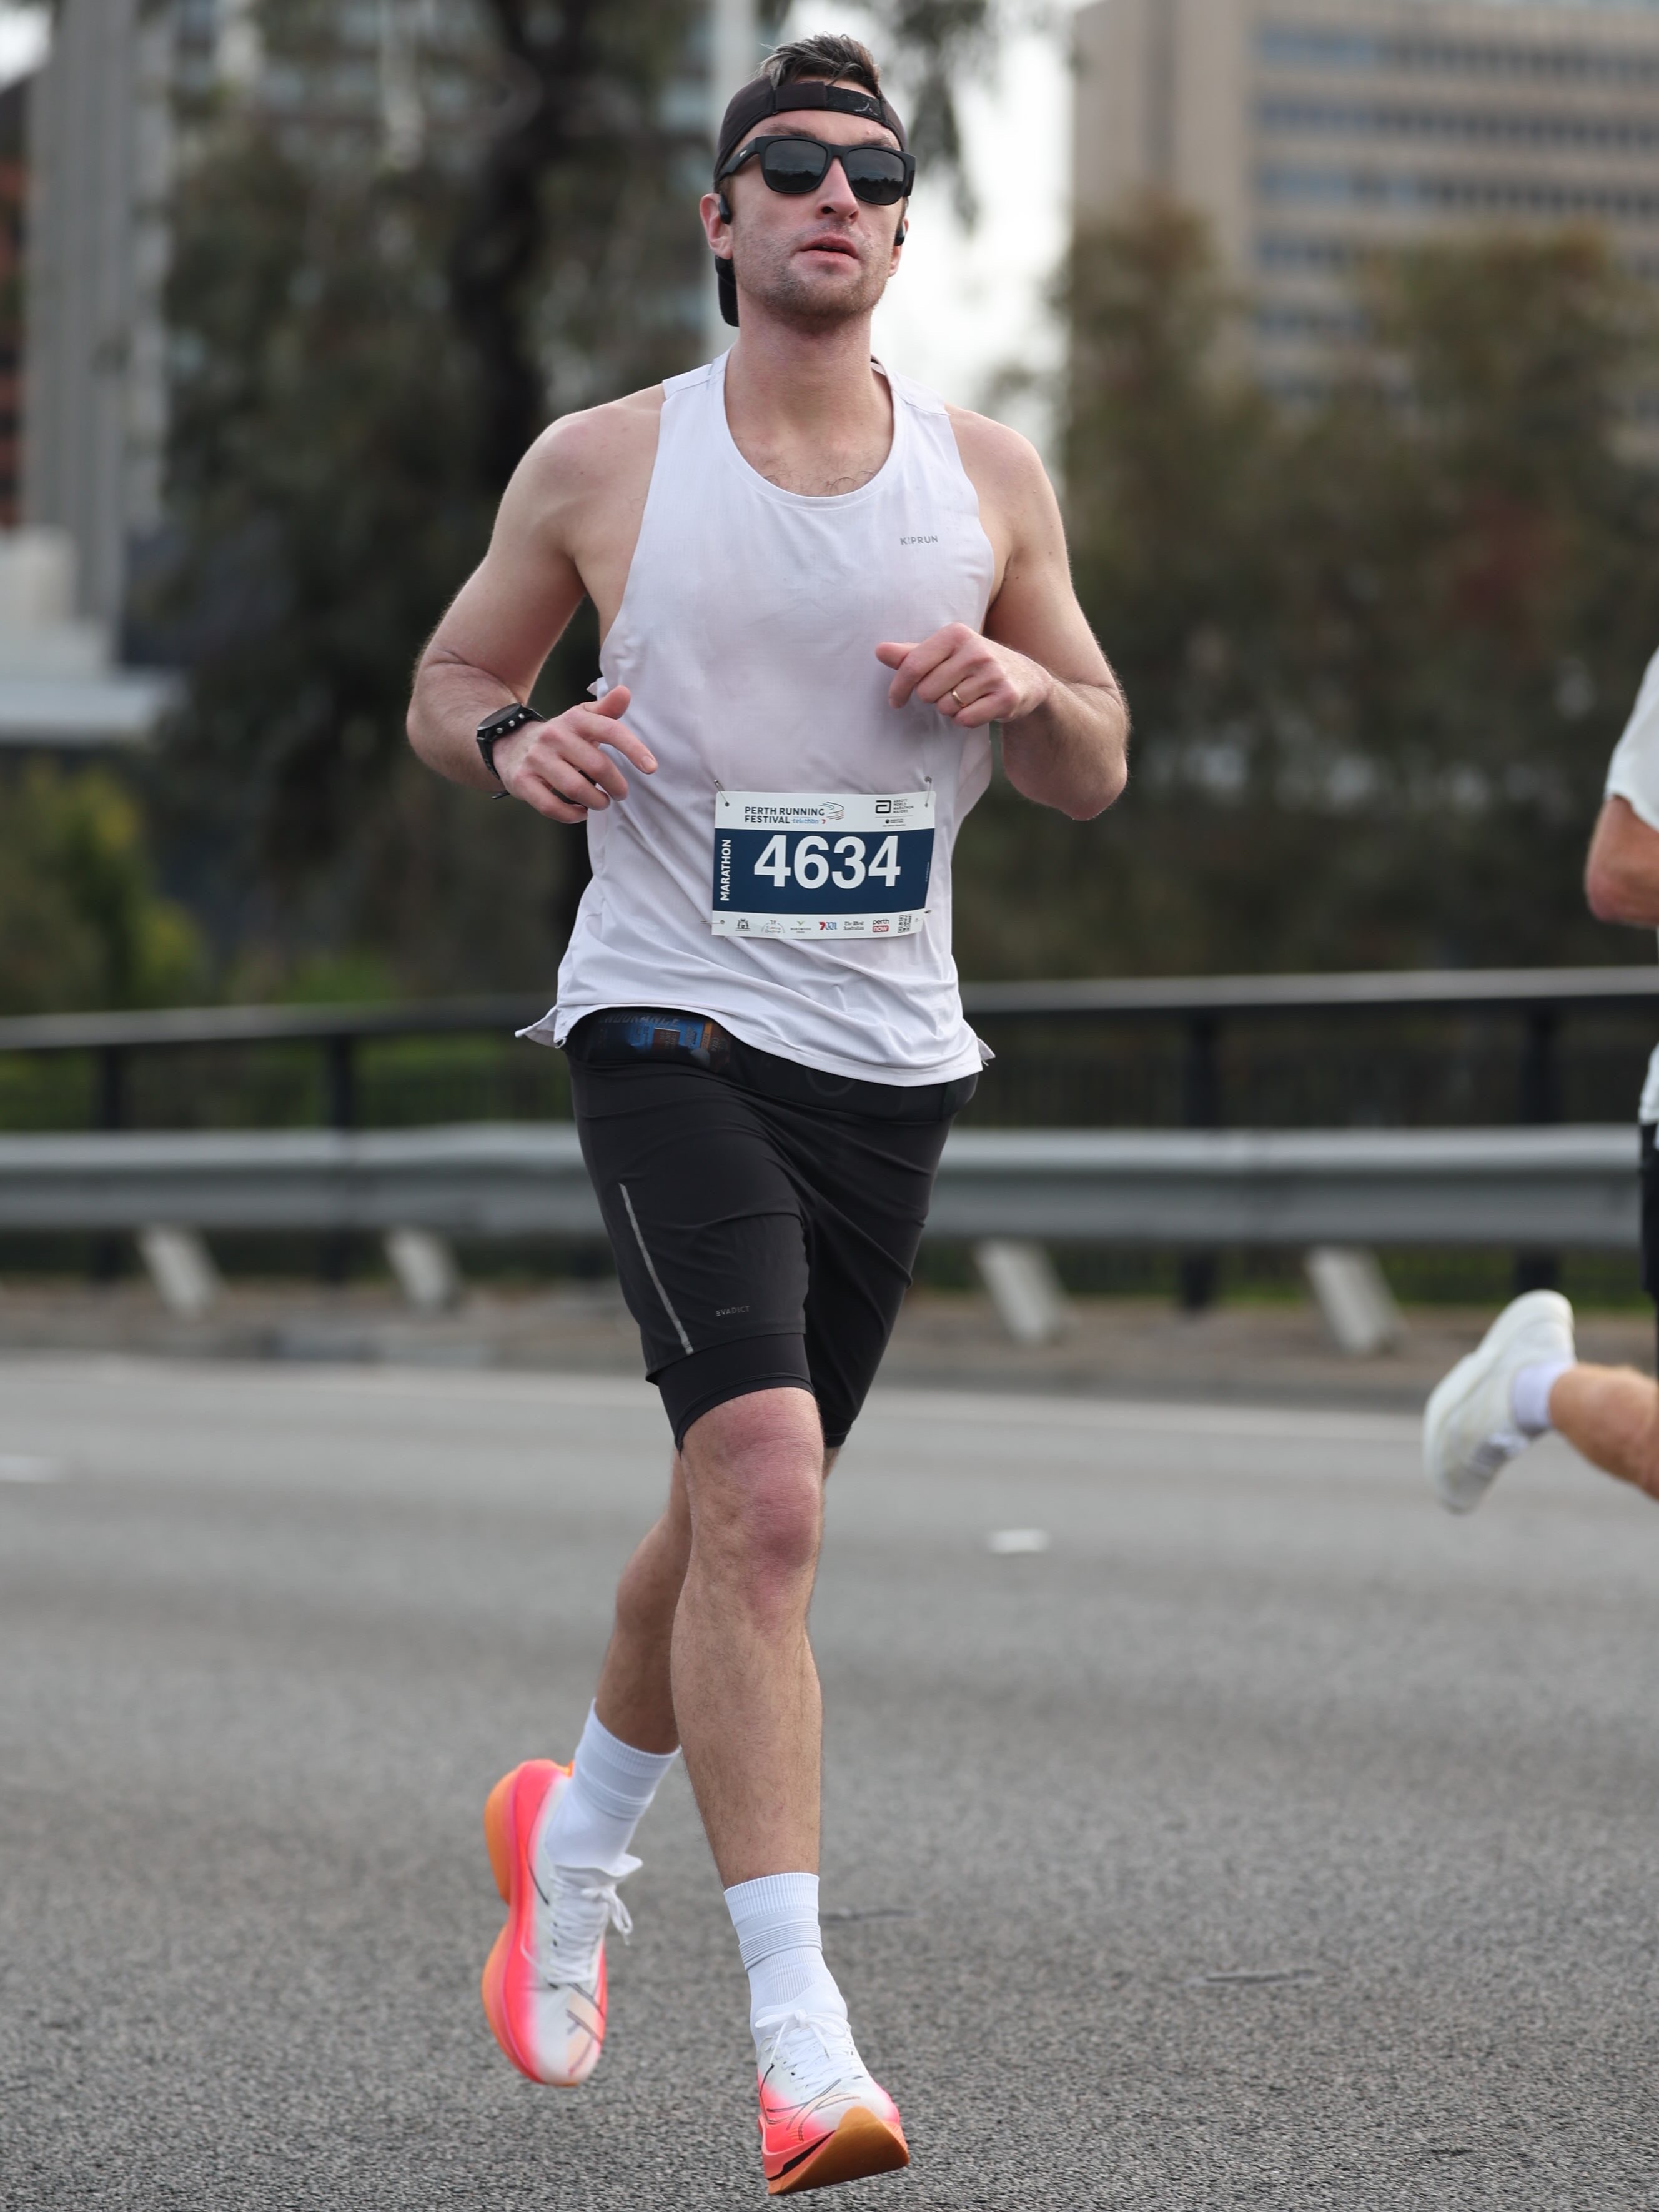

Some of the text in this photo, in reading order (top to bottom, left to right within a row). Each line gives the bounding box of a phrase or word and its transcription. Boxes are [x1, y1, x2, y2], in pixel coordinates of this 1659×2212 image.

[900, 535, 938, 545] KIPRUN
[745, 806, 825, 816] PERTH RUNNING
[744, 815, 790, 824] FESTIVAL
[754, 835, 901, 889] 4634
[720, 839, 731, 901] MARATHON
[715, 1306, 750, 1316] EVADICT
